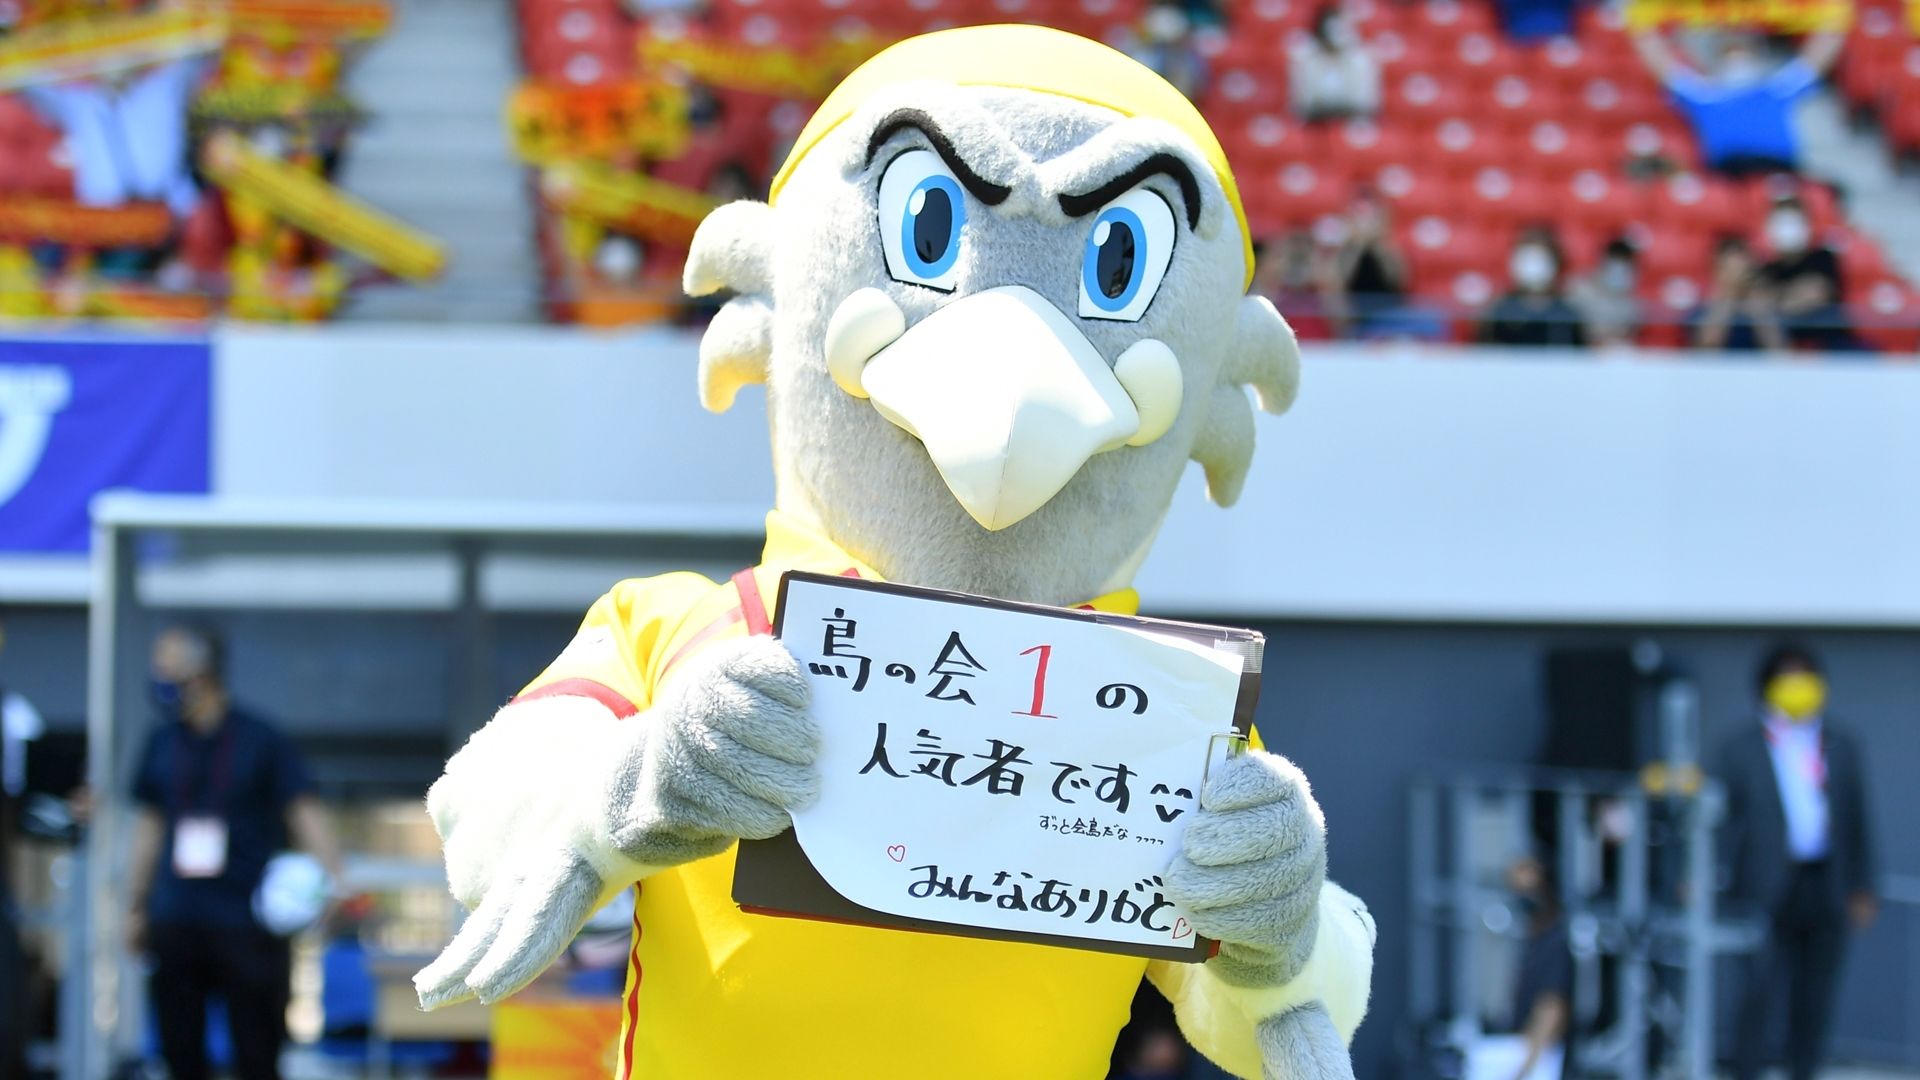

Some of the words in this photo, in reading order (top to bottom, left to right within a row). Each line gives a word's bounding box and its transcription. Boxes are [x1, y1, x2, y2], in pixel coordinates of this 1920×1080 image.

[858, 722, 1138, 814] 人気者です
[907, 864, 1176, 932] みんなありがと
